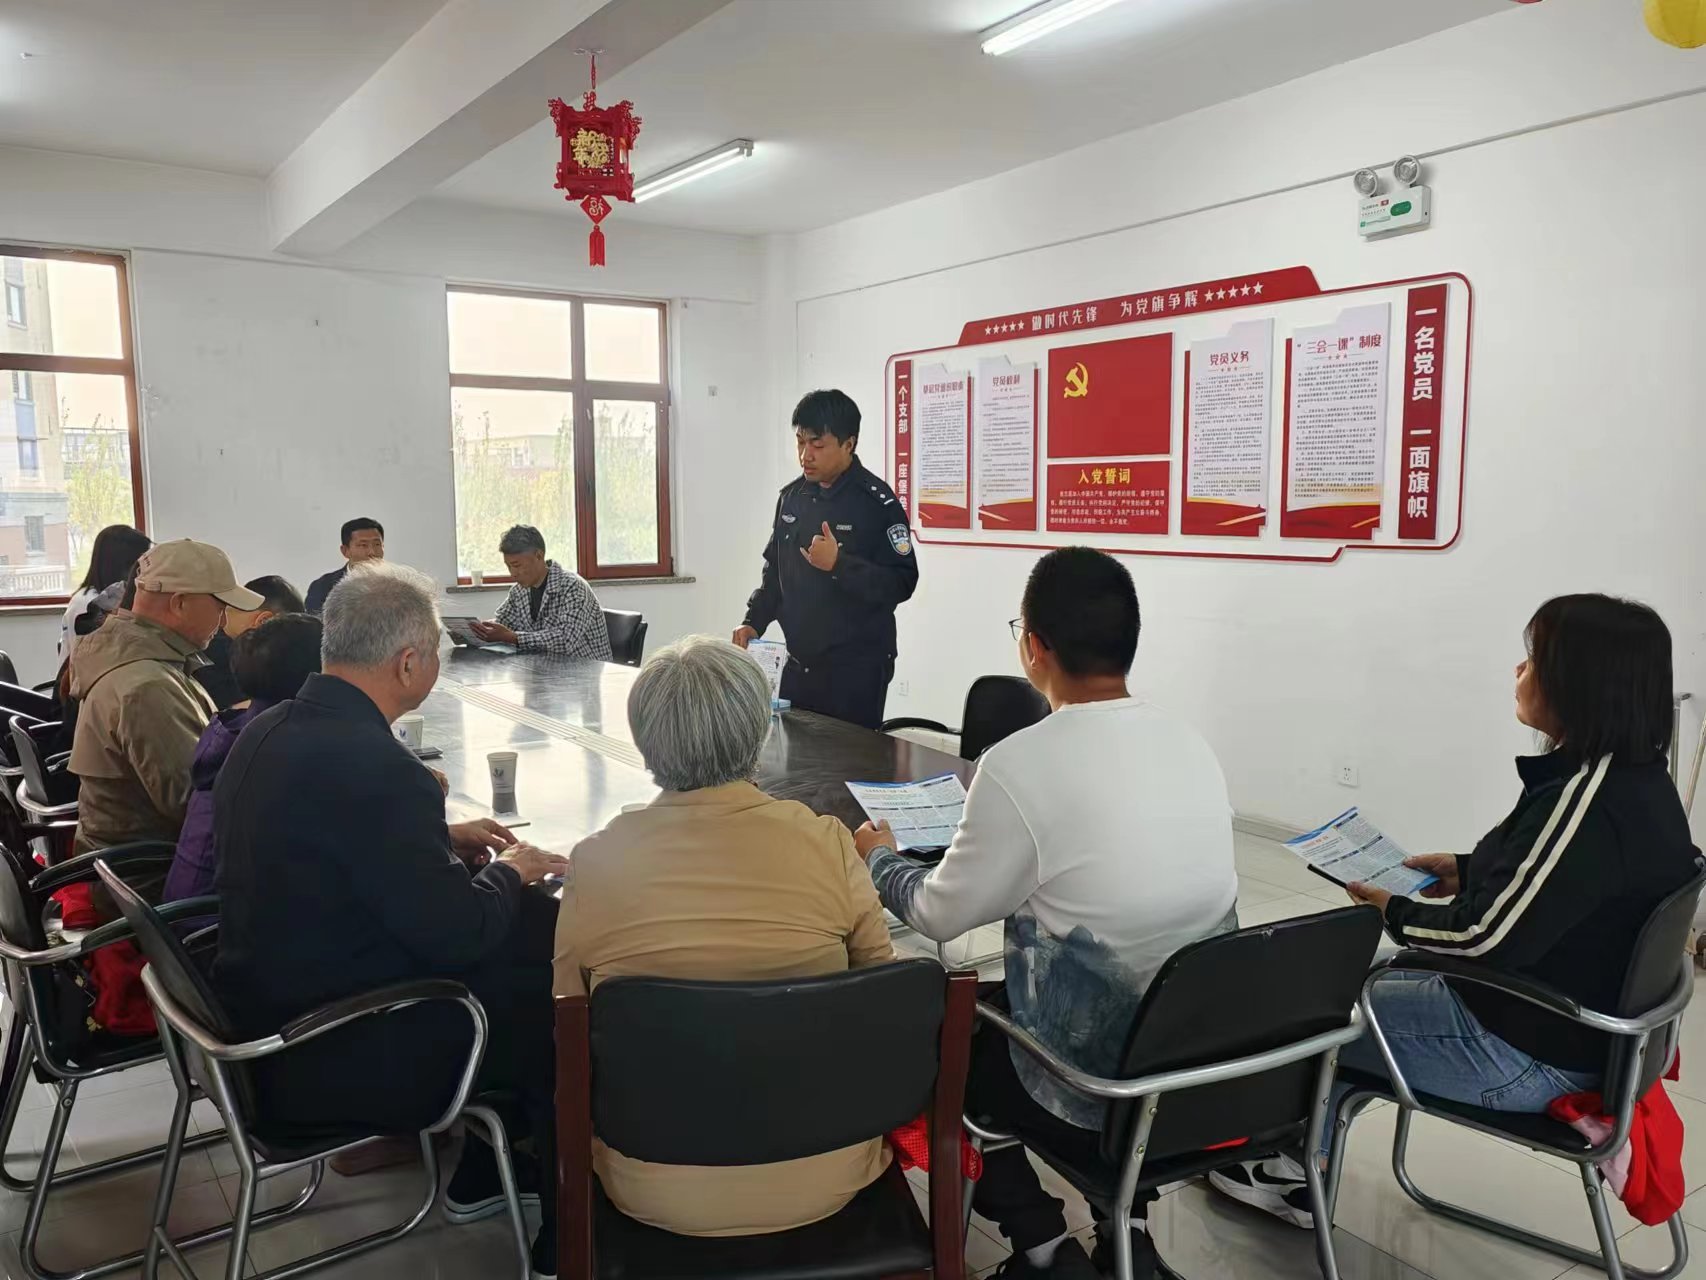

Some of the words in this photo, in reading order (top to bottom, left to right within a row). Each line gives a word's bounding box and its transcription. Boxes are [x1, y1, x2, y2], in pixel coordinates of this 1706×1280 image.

[1032, 306, 1098, 331] 做时代先锋
[1120, 290, 1198, 318] 为党旗争辉
[1209, 351, 1250, 366] 党员义务
[1411, 307, 1438, 401] 一名党员
[898, 374, 908, 434] 一个支部
[1078, 467, 1131, 485] 入党誓词
[1407, 429, 1432, 518] 一面旗帜
